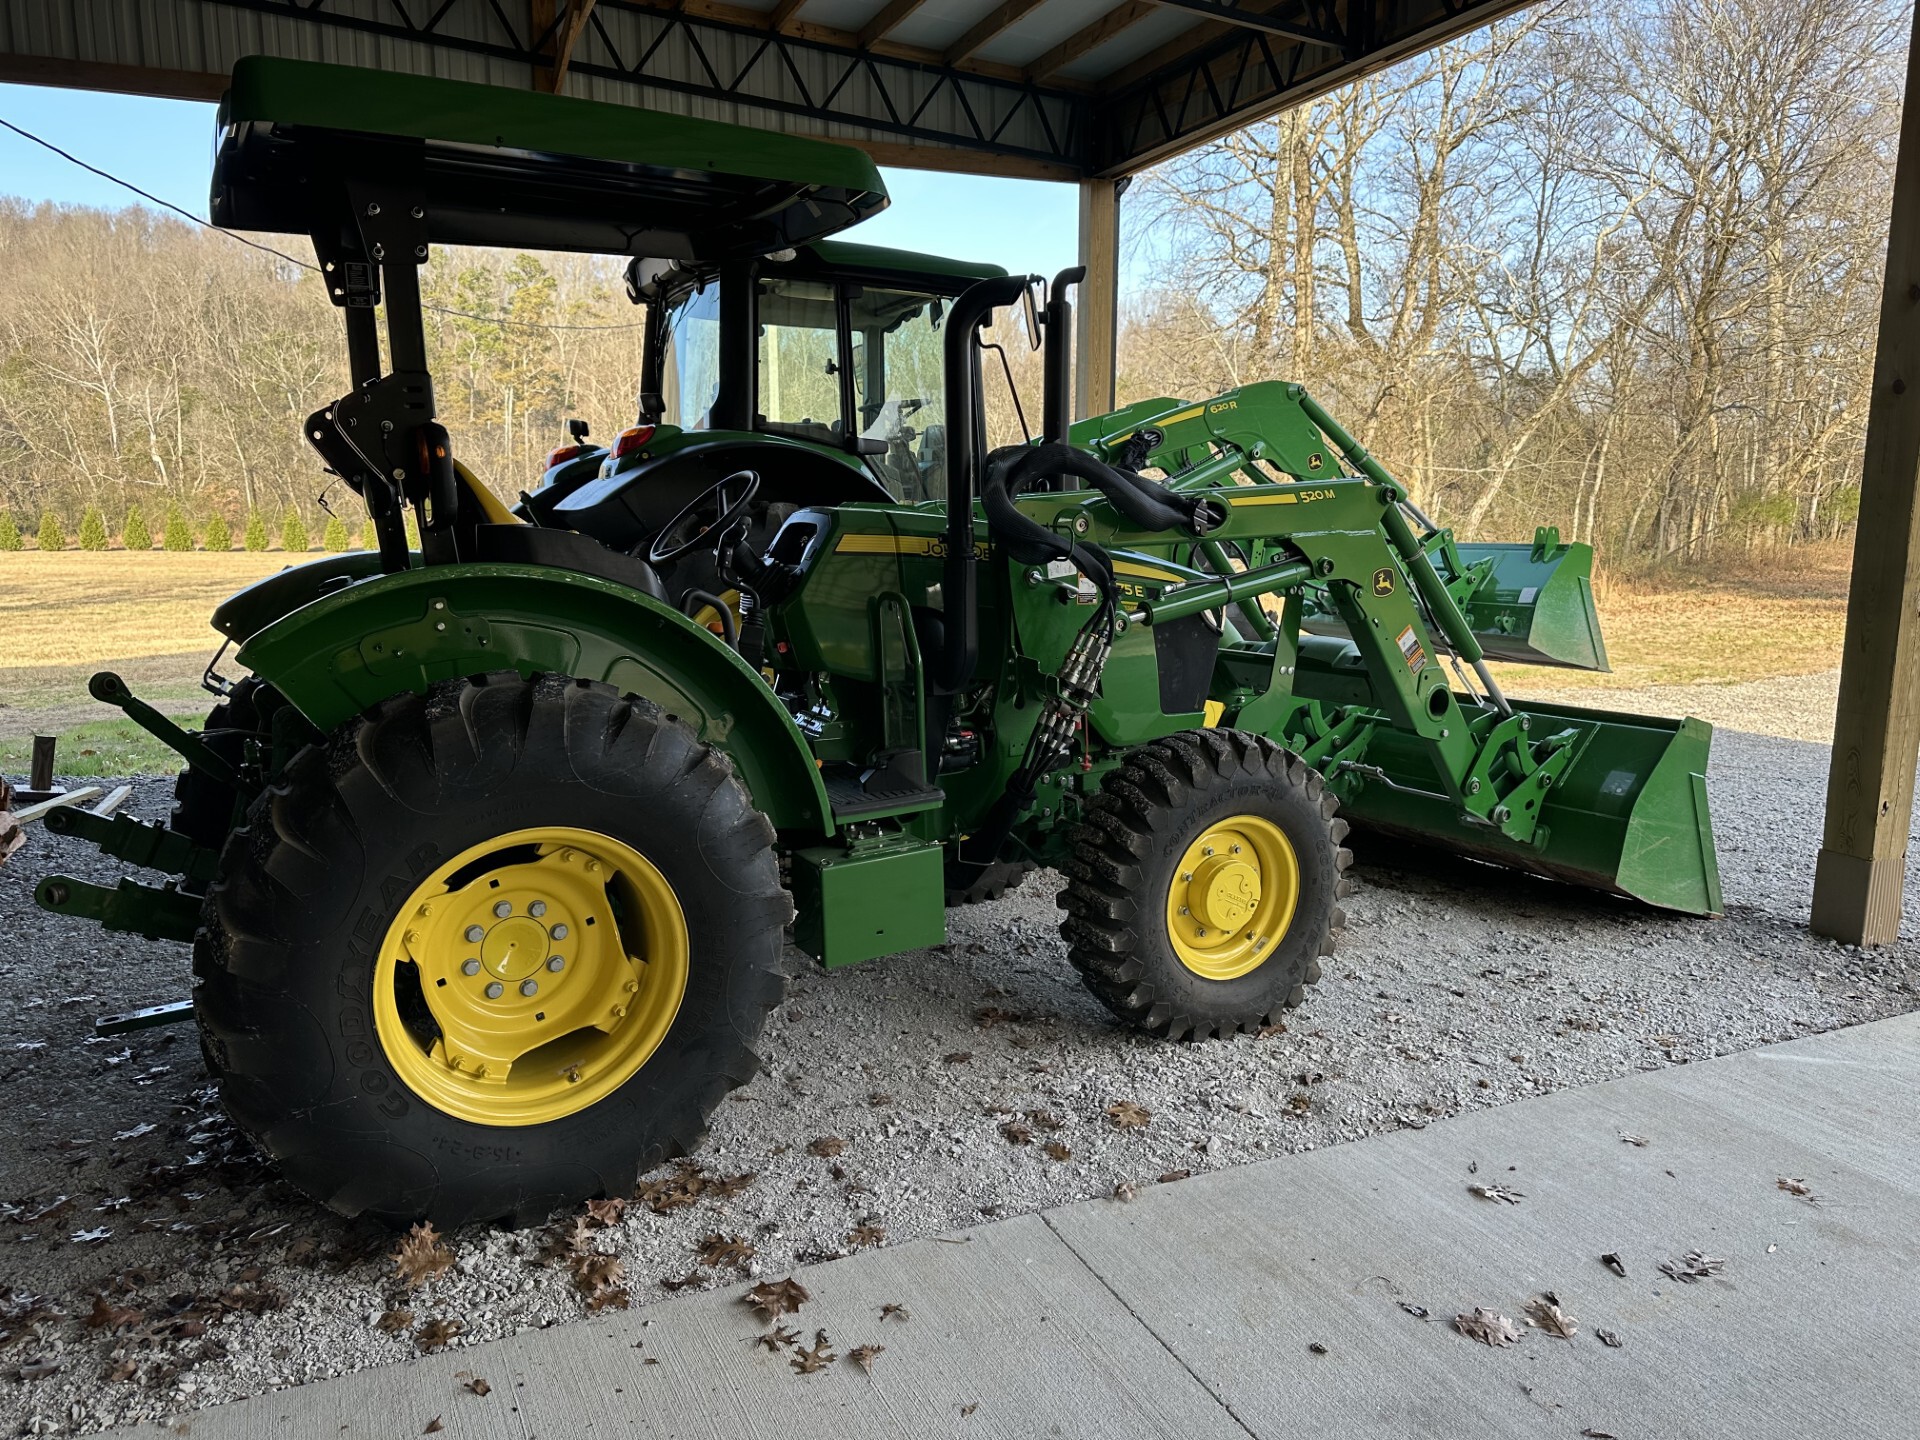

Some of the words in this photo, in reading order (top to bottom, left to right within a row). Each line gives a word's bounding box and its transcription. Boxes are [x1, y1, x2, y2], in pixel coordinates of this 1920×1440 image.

[1209, 403, 1229, 414] 620
[1228, 401, 1238, 410] R
[1299, 490, 1324, 503] 520
[1325, 489, 1336, 500] M
[1134, 585, 1145, 598] E
[337, 840, 443, 1120] GOODYEAR
